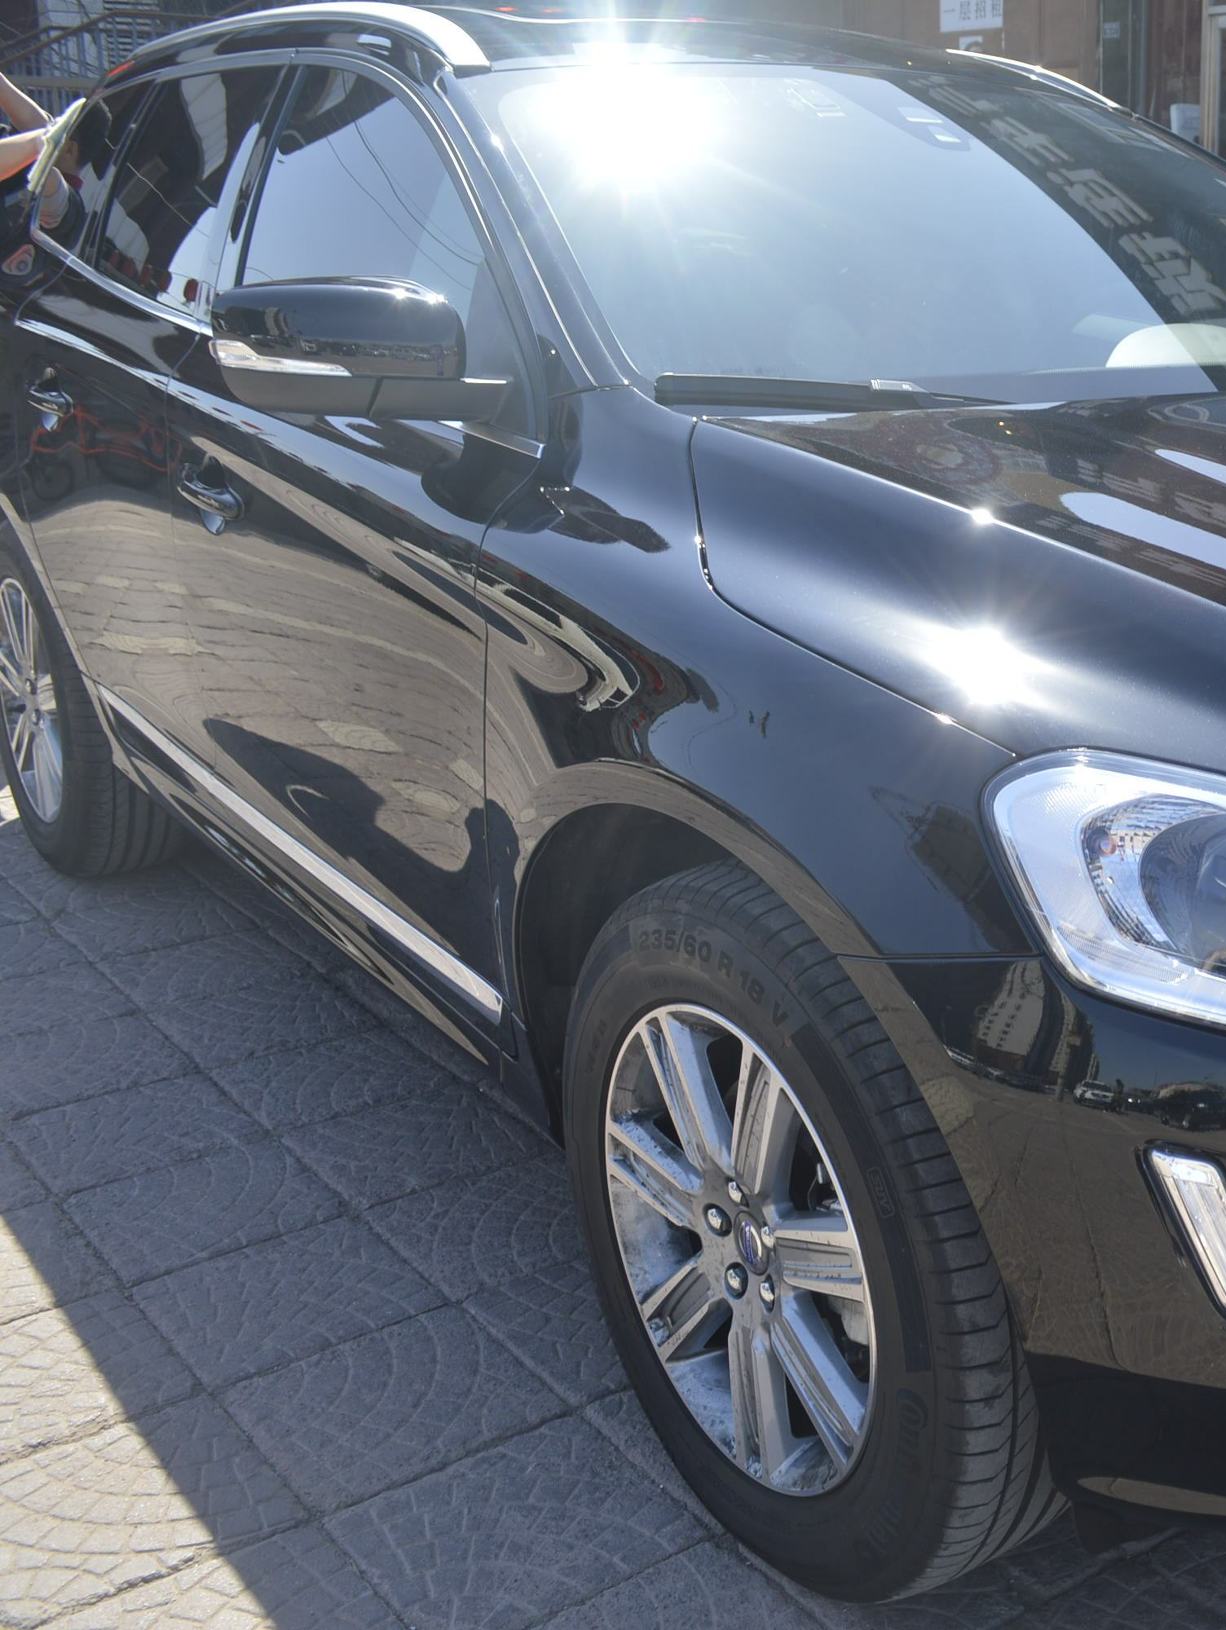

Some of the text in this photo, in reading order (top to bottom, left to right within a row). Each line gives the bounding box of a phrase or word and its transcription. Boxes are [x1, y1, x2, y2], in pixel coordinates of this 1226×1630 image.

[639, 928, 790, 1027] 235/60 R 18 V
